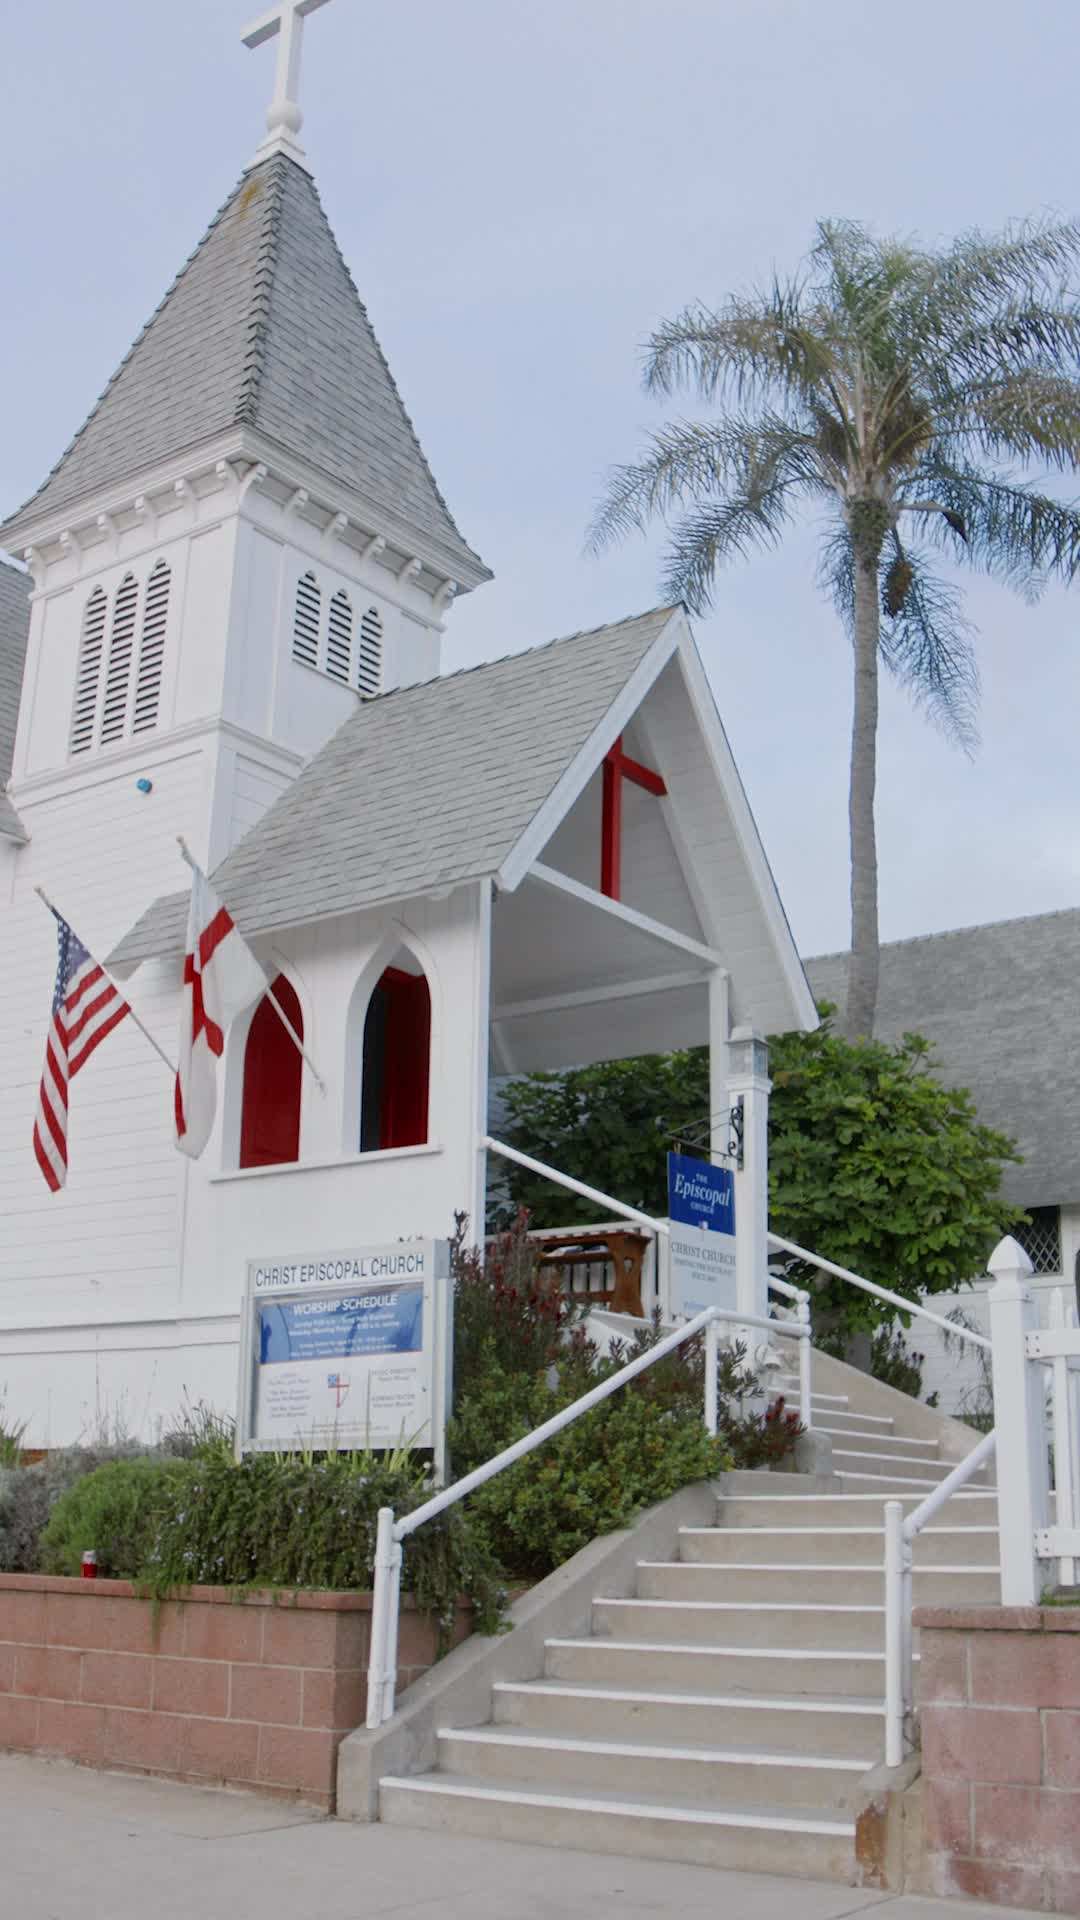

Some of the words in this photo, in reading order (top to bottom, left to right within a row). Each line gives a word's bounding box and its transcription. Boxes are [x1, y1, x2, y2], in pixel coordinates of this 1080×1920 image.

[674, 1173, 730, 1206] Episcopal
[671, 1242, 701, 1258] CHRIST
[702, 1249, 736, 1265] CHURCH
[255, 1266, 297, 1287] CHRIST
[300, 1260, 367, 1282] EPISCOPAL
[371, 1255, 424, 1276] CHURCH
[293, 1301, 340, 1315] WORSHIP
[342, 1294, 398, 1310] SCHEDULE
